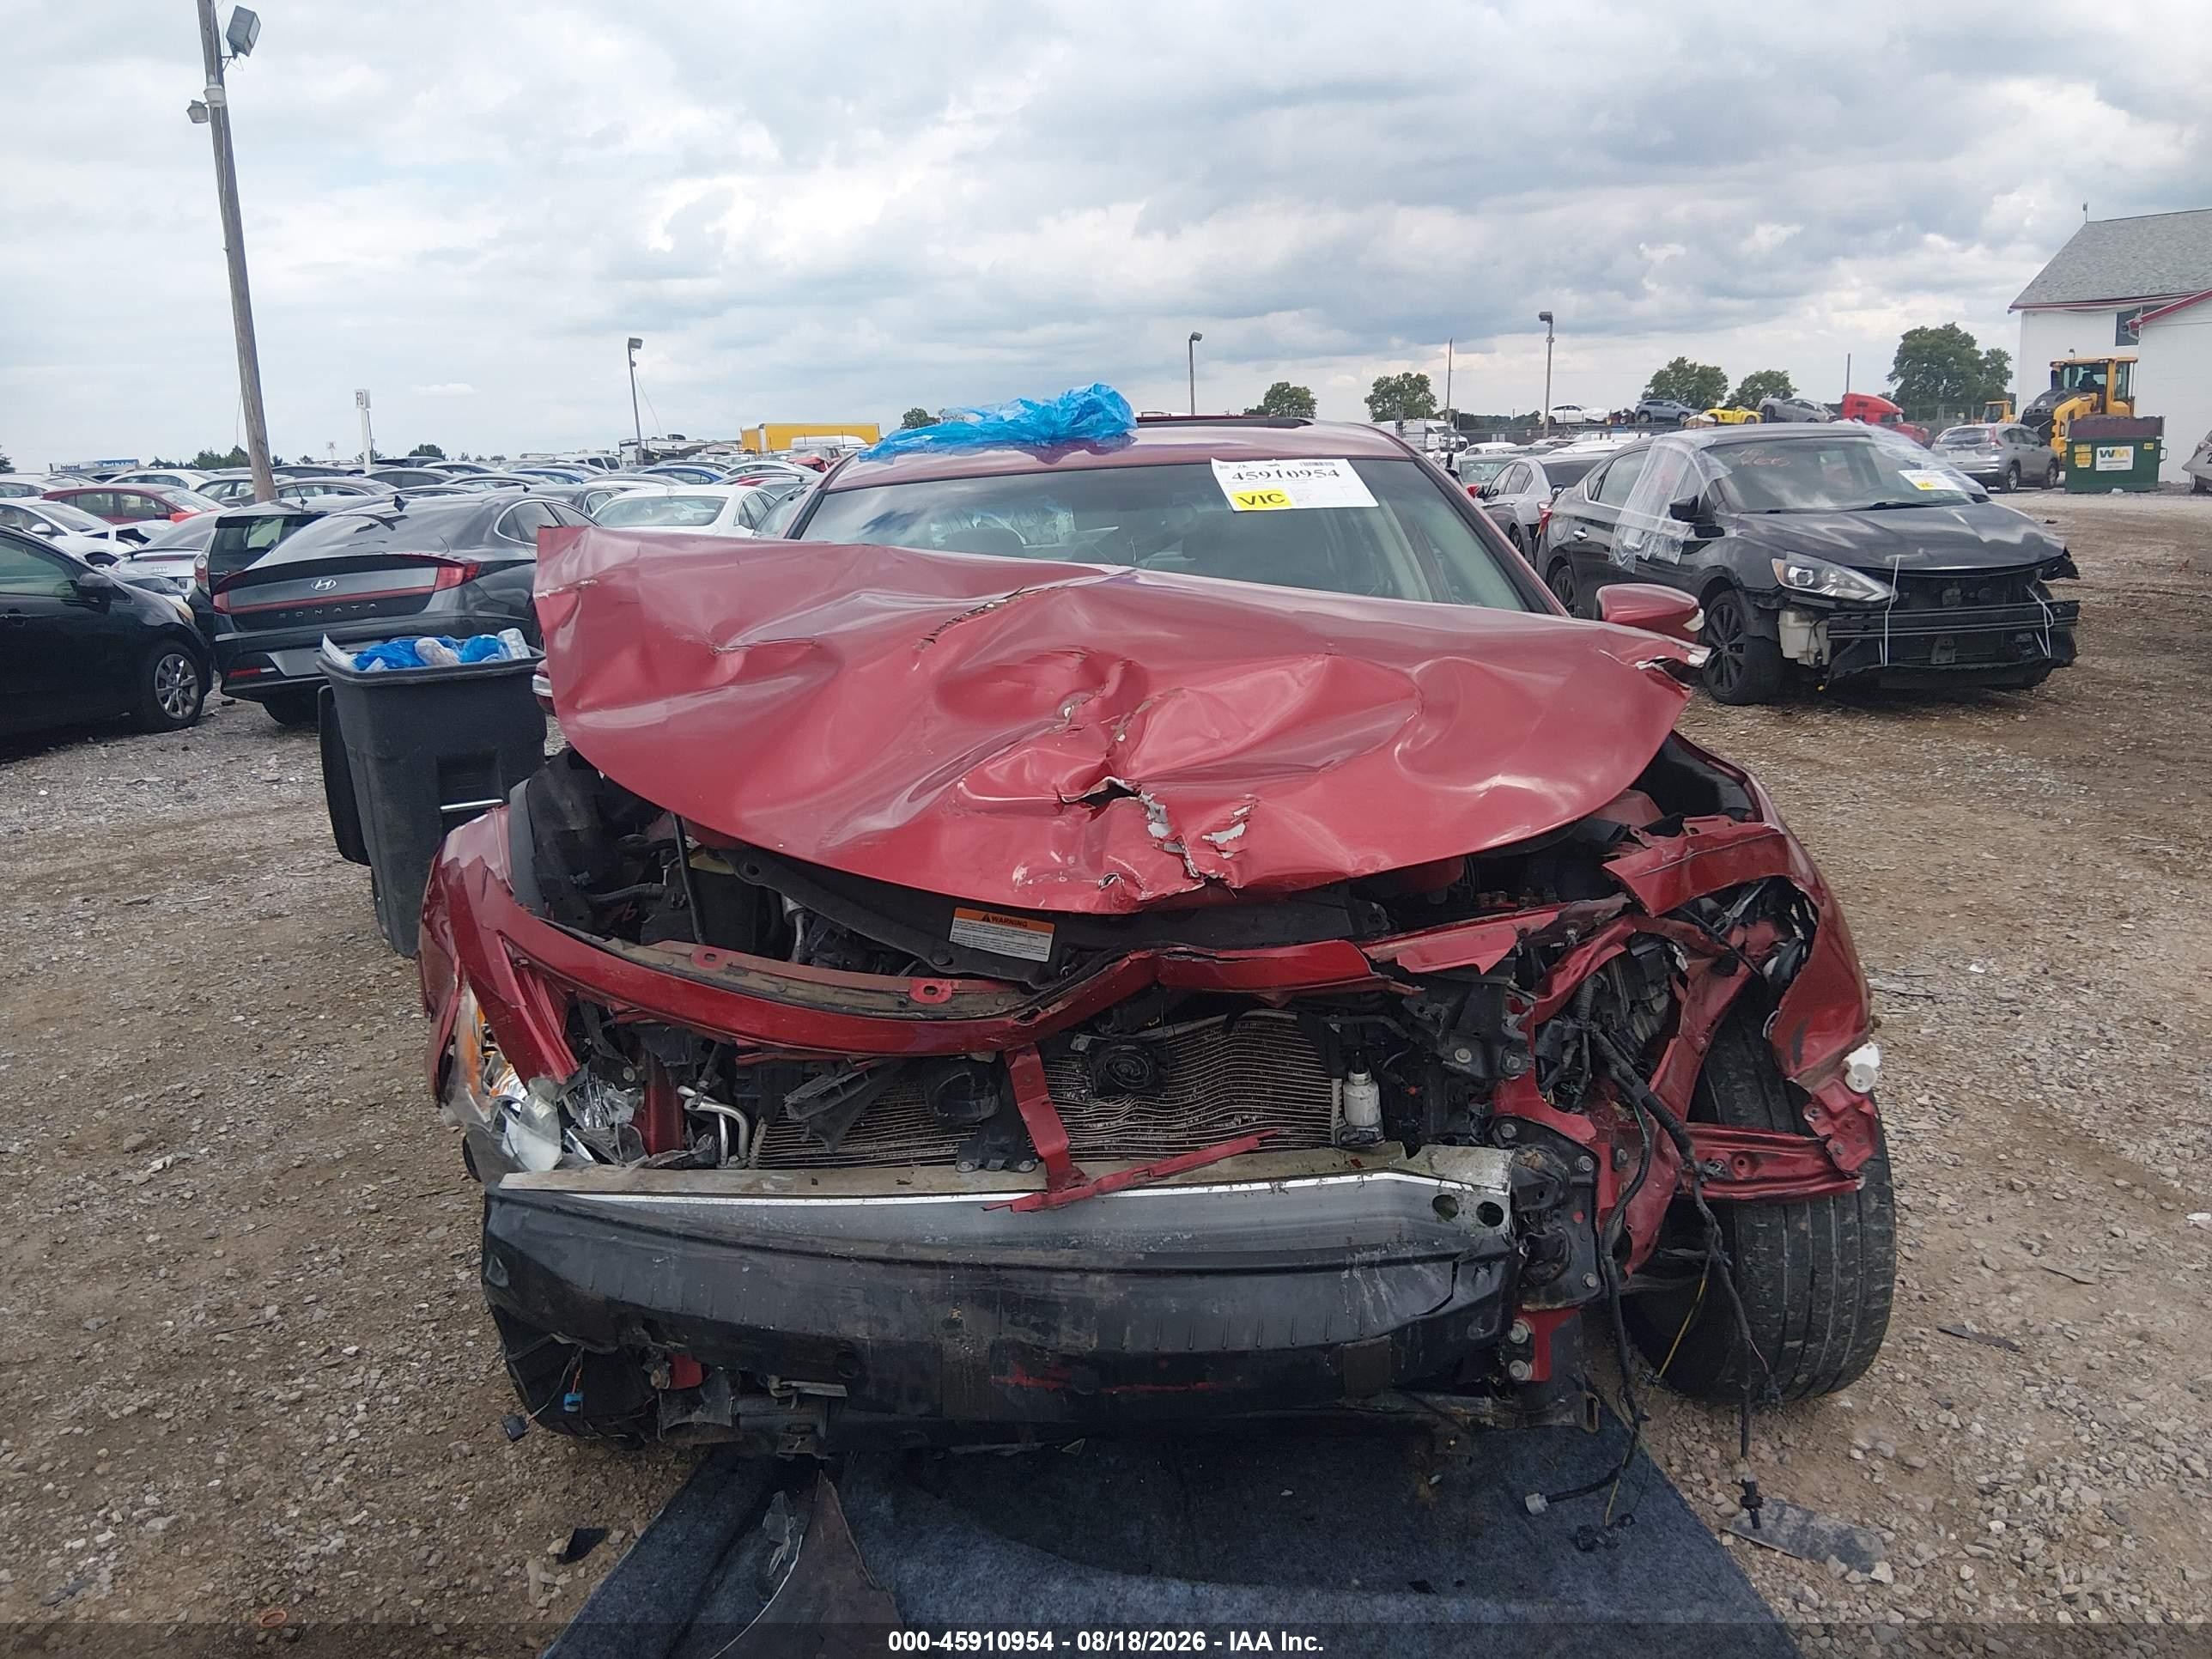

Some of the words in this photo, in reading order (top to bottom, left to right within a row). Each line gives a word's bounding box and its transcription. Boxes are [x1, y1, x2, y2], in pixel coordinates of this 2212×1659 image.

[2100, 449, 2130, 459] WM
[1231, 468, 1340, 481] 45910954
[1239, 493, 1285, 506] VIC
[992, 915, 1028, 928] WARNING
